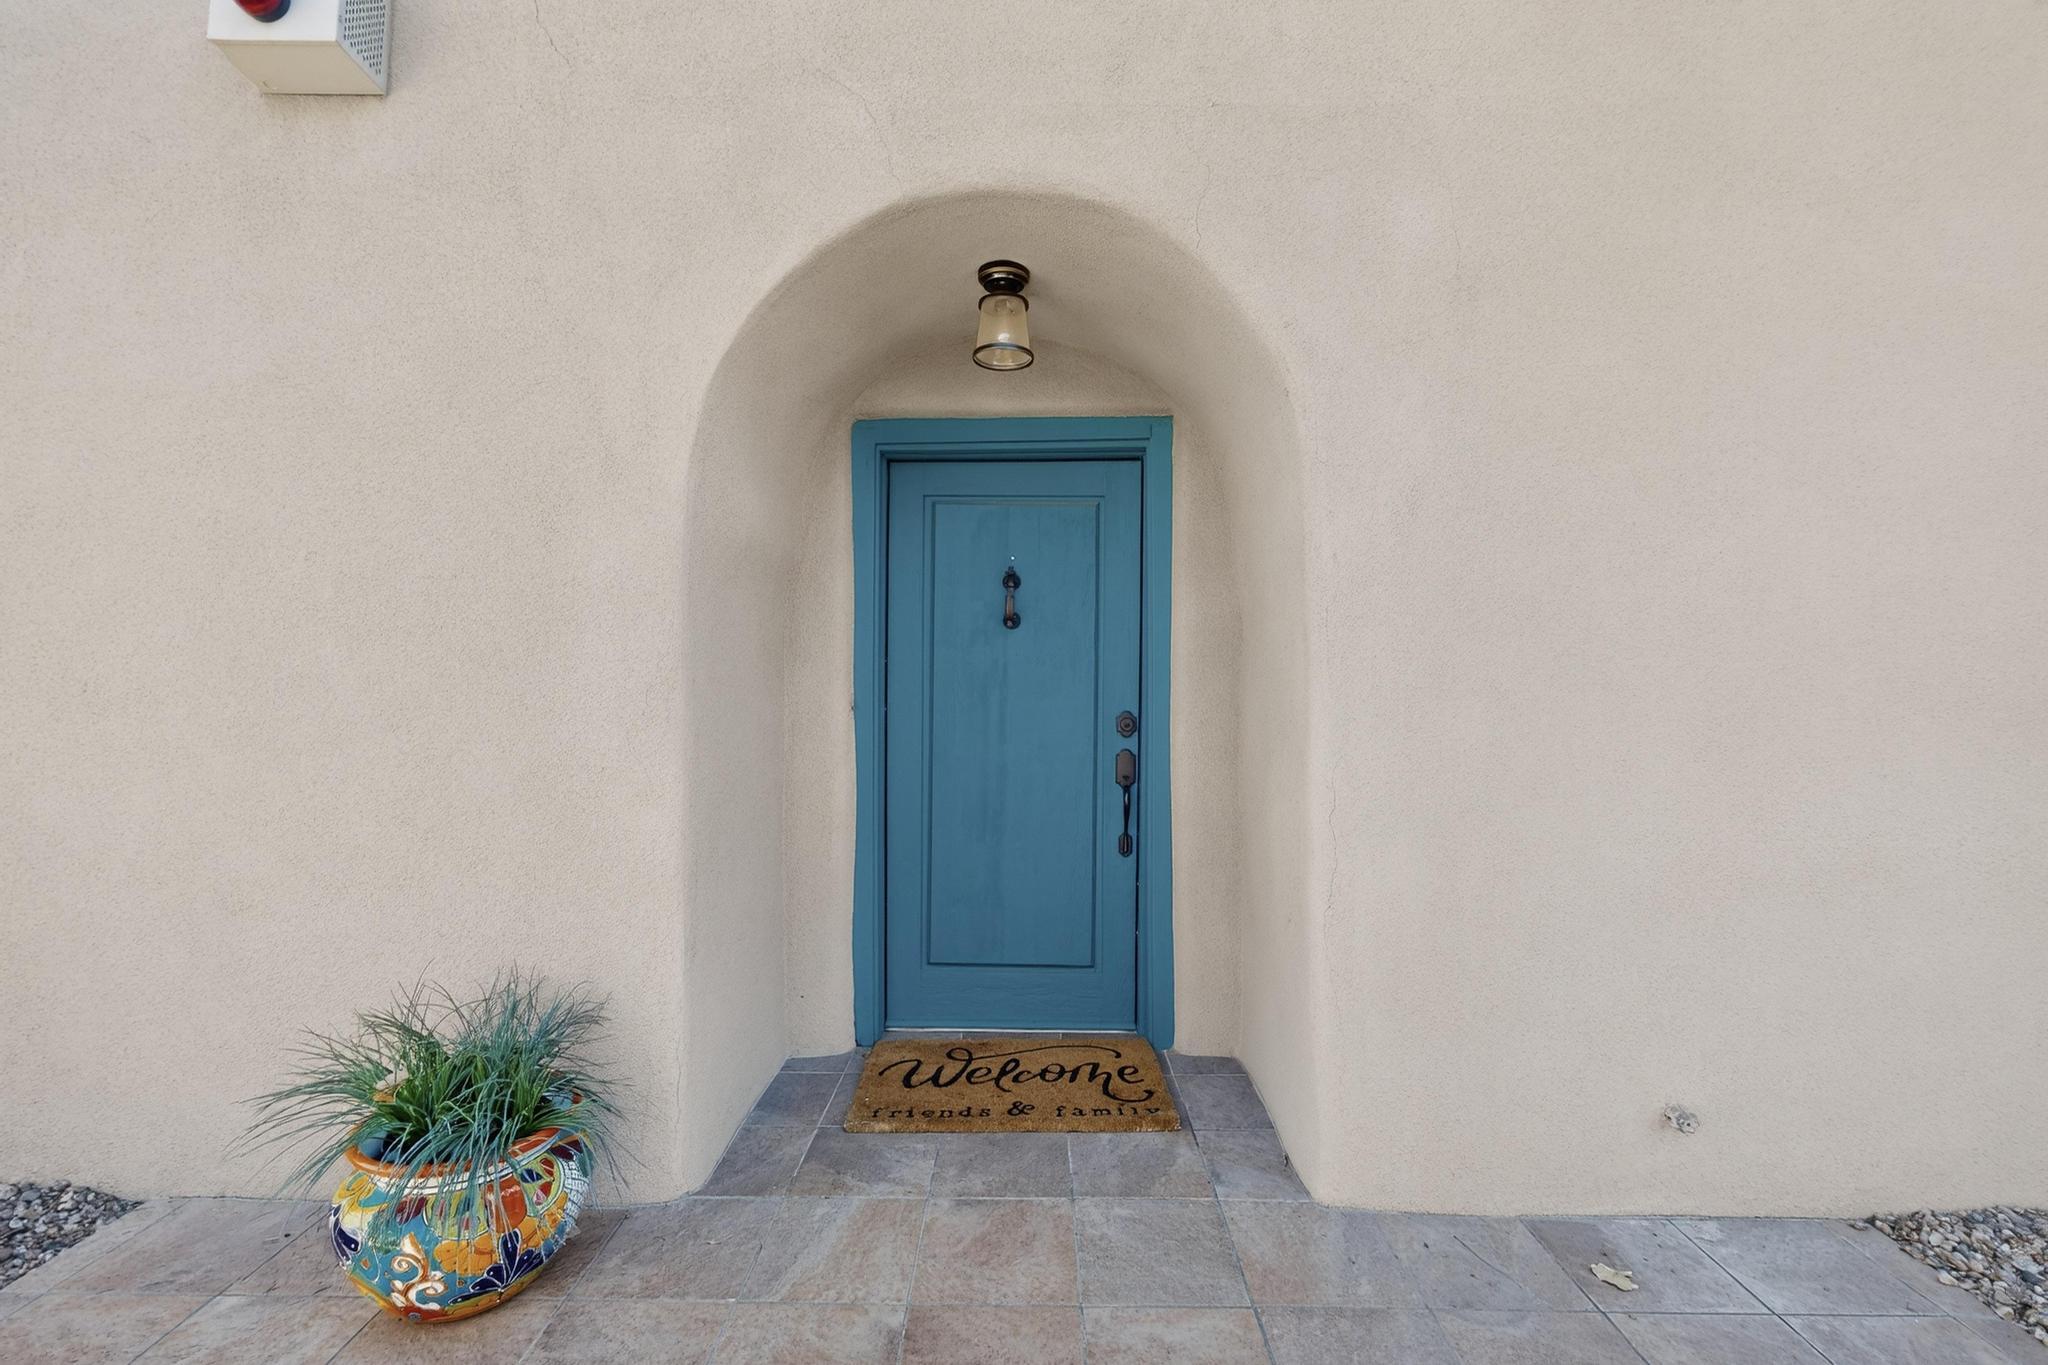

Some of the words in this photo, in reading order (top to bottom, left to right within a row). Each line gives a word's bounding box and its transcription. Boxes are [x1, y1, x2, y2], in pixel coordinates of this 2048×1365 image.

[878, 1045, 1154, 1102] Welcome
[871, 1106, 992, 1119] friends
[1006, 1100, 1036, 1117] &
